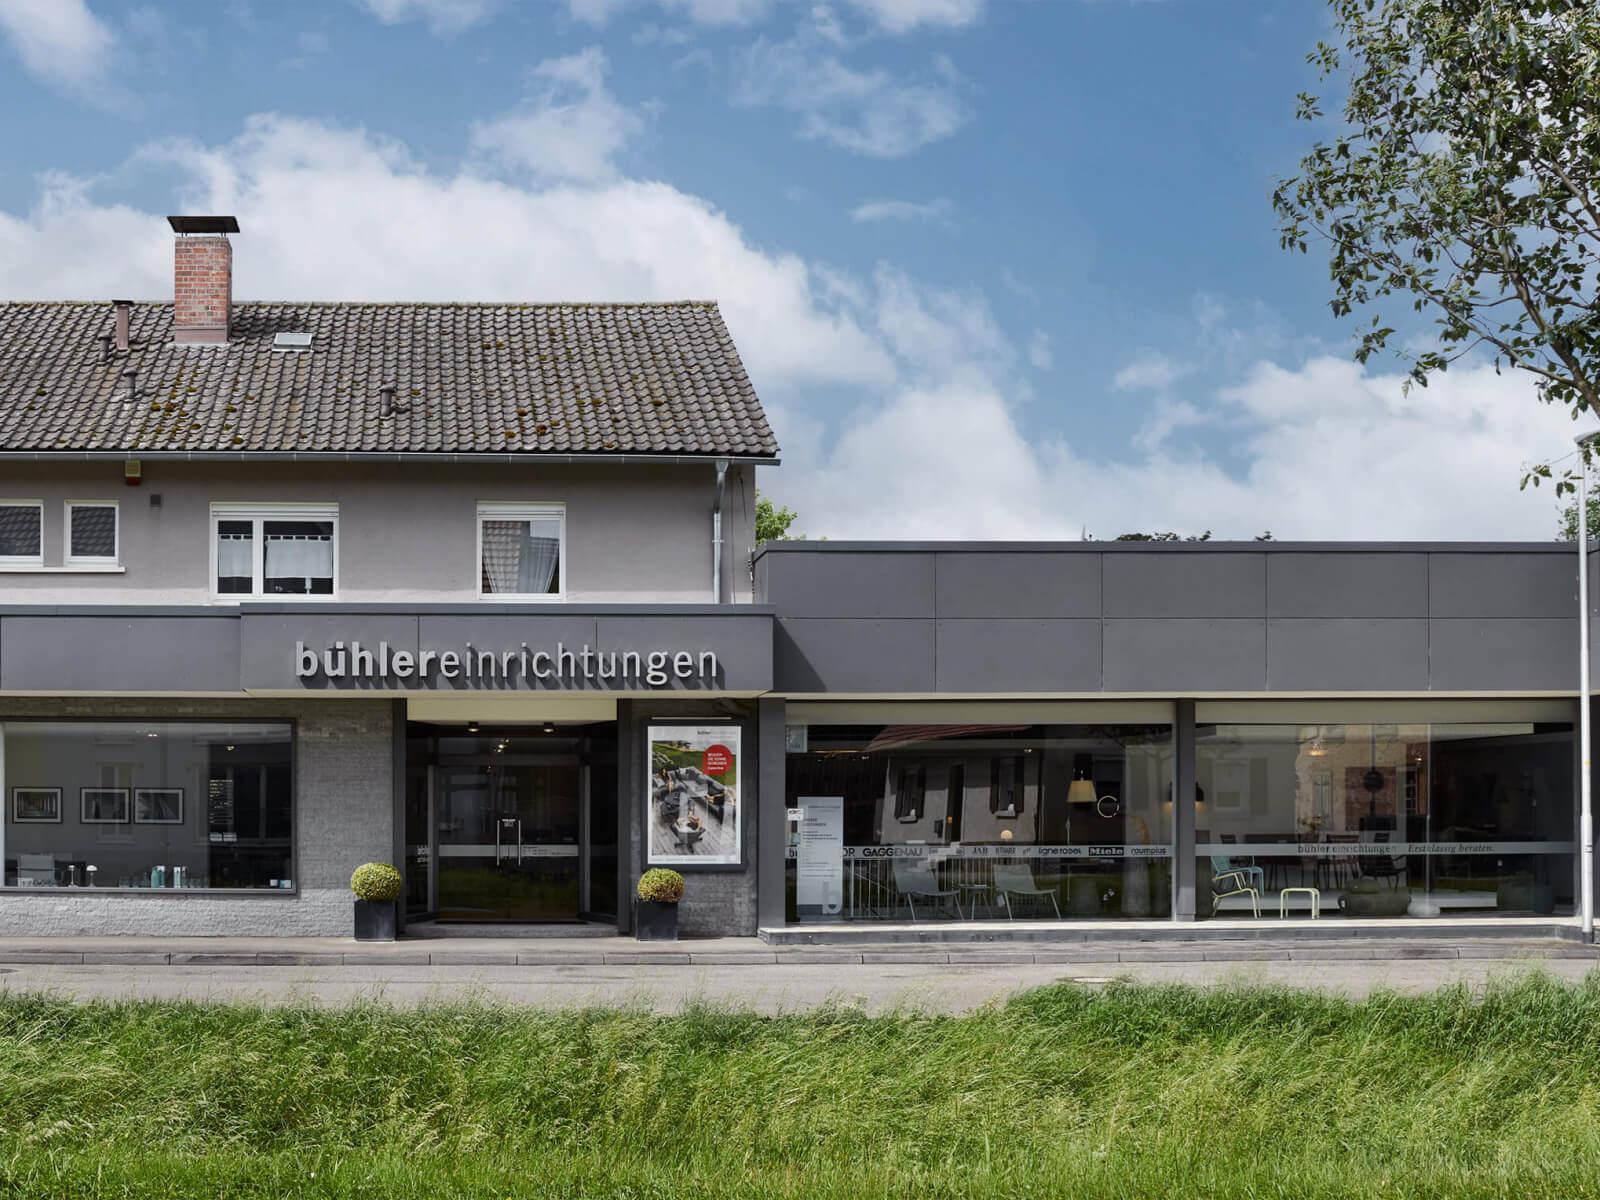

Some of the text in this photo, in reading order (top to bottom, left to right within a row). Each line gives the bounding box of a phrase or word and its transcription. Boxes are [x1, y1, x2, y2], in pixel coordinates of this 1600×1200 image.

[295, 640, 718, 685] bühlereinrichtungen
[863, 847, 923, 857] GAGGENAU
[1089, 847, 1124, 856] Miele
